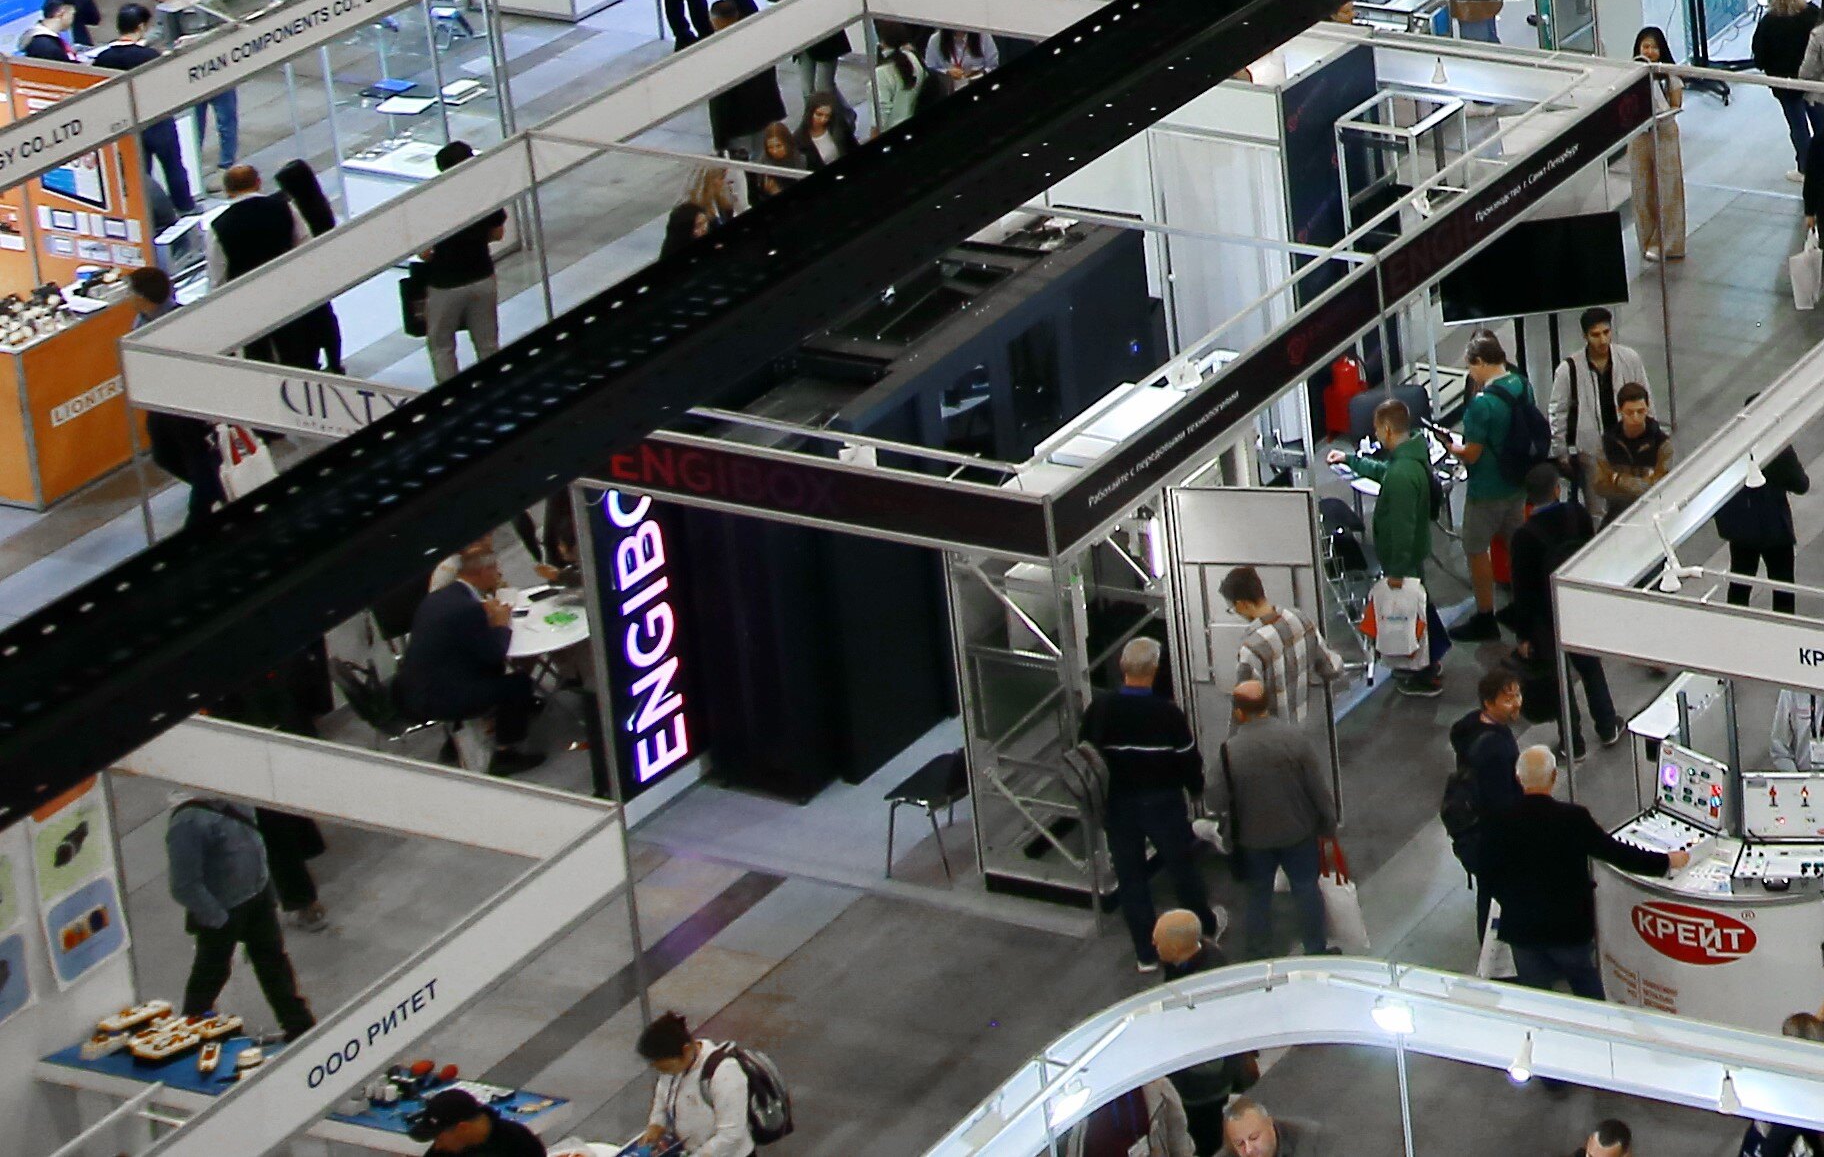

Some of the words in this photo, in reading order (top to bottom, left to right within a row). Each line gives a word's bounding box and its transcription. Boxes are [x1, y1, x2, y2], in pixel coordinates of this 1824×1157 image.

[187, 52, 229, 85] RYAN
[230, 6, 331, 65] COMPONENTS
[1087, 470, 1132, 509] Работайте
[1136, 429, 1186, 471] передовыми
[1184, 389, 1240, 433] технологиями
[1637, 910, 1746, 957] КРЕЙТ
[305, 1037, 362, 1091] ООО
[366, 977, 440, 1049] РИТЕТ
